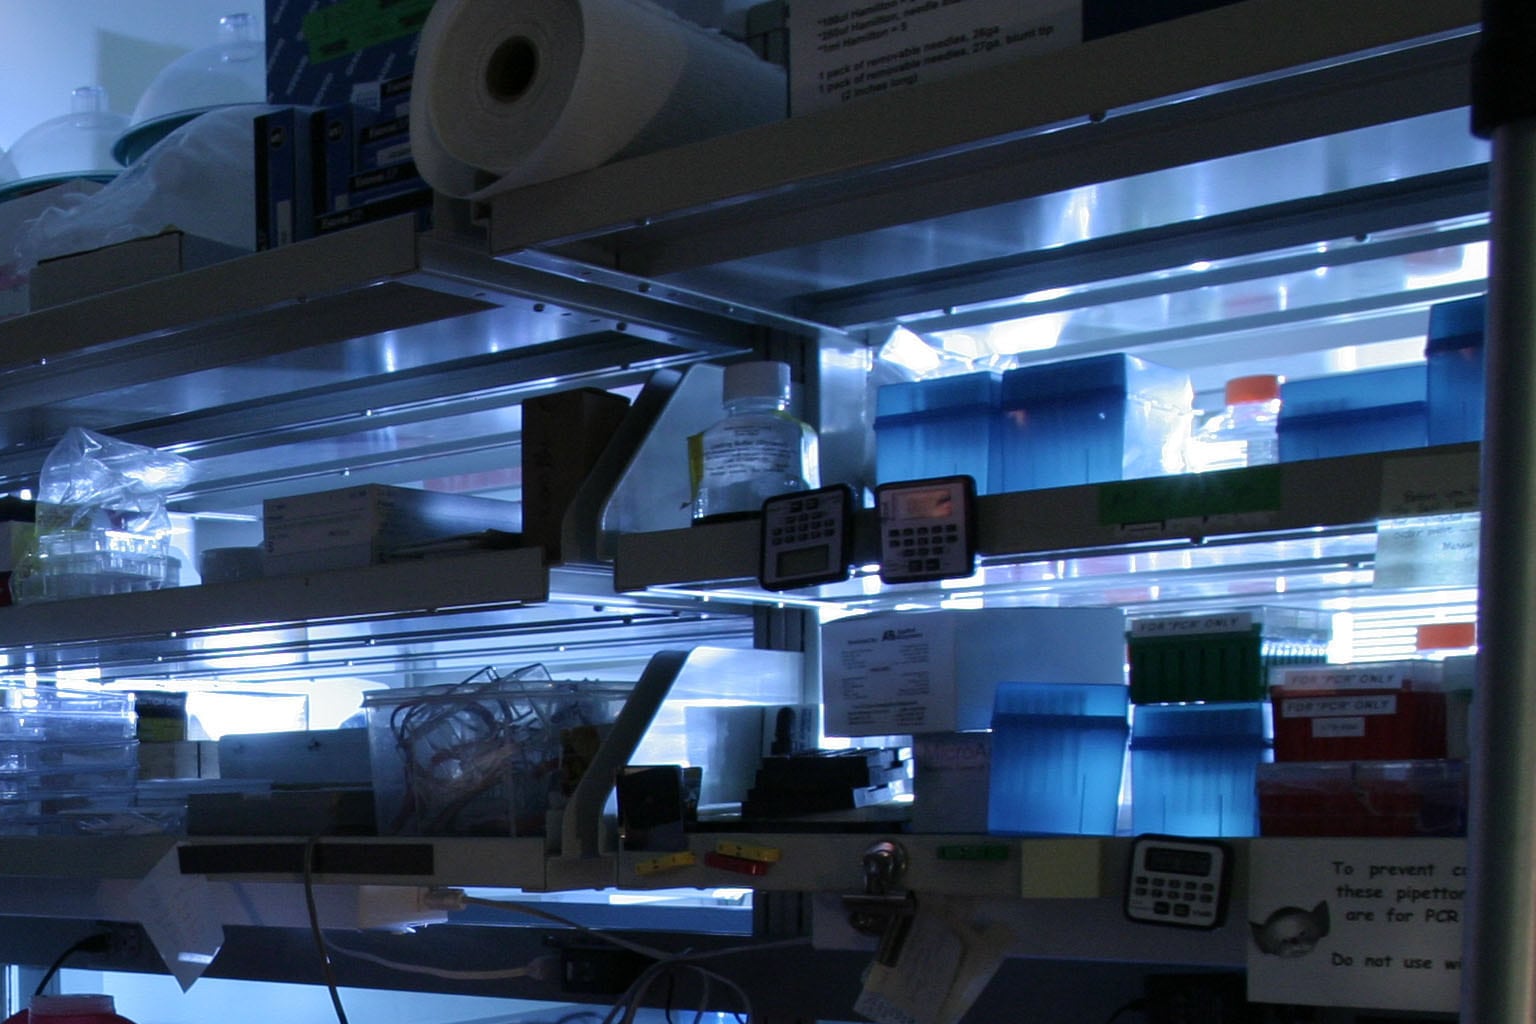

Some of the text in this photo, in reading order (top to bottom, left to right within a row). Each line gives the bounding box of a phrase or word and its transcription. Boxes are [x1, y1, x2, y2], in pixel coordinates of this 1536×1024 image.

[827, 78, 851, 94] pack
[853, 74, 865, 85] of
[866, 60, 921, 80] removable
[1037, 24, 1055, 37] tip
[827, 65, 851, 80] pack
[854, 61, 865, 71] of
[866, 47, 921, 67] removable
[854, 81, 889, 97] inches
[890, 73, 918, 88] long)
[1139, 620, 1166, 631] FOR
[1203, 615, 1240, 629] ONLY
[1289, 673, 1322, 685] FOR
[1359, 672, 1396, 684] ONLY
[1285, 701, 1316, 713] FOR
[1352, 699, 1389, 711] ONLY
[1331, 860, 1354, 876] To
[1369, 863, 1435, 879] prevent
[1336, 885, 1384, 899] these
[1345, 908, 1459, 923] are for PCR
[1331, 952, 1354, 967] Do
[1365, 955, 1393, 967] not
[1403, 958, 1433, 969] use
